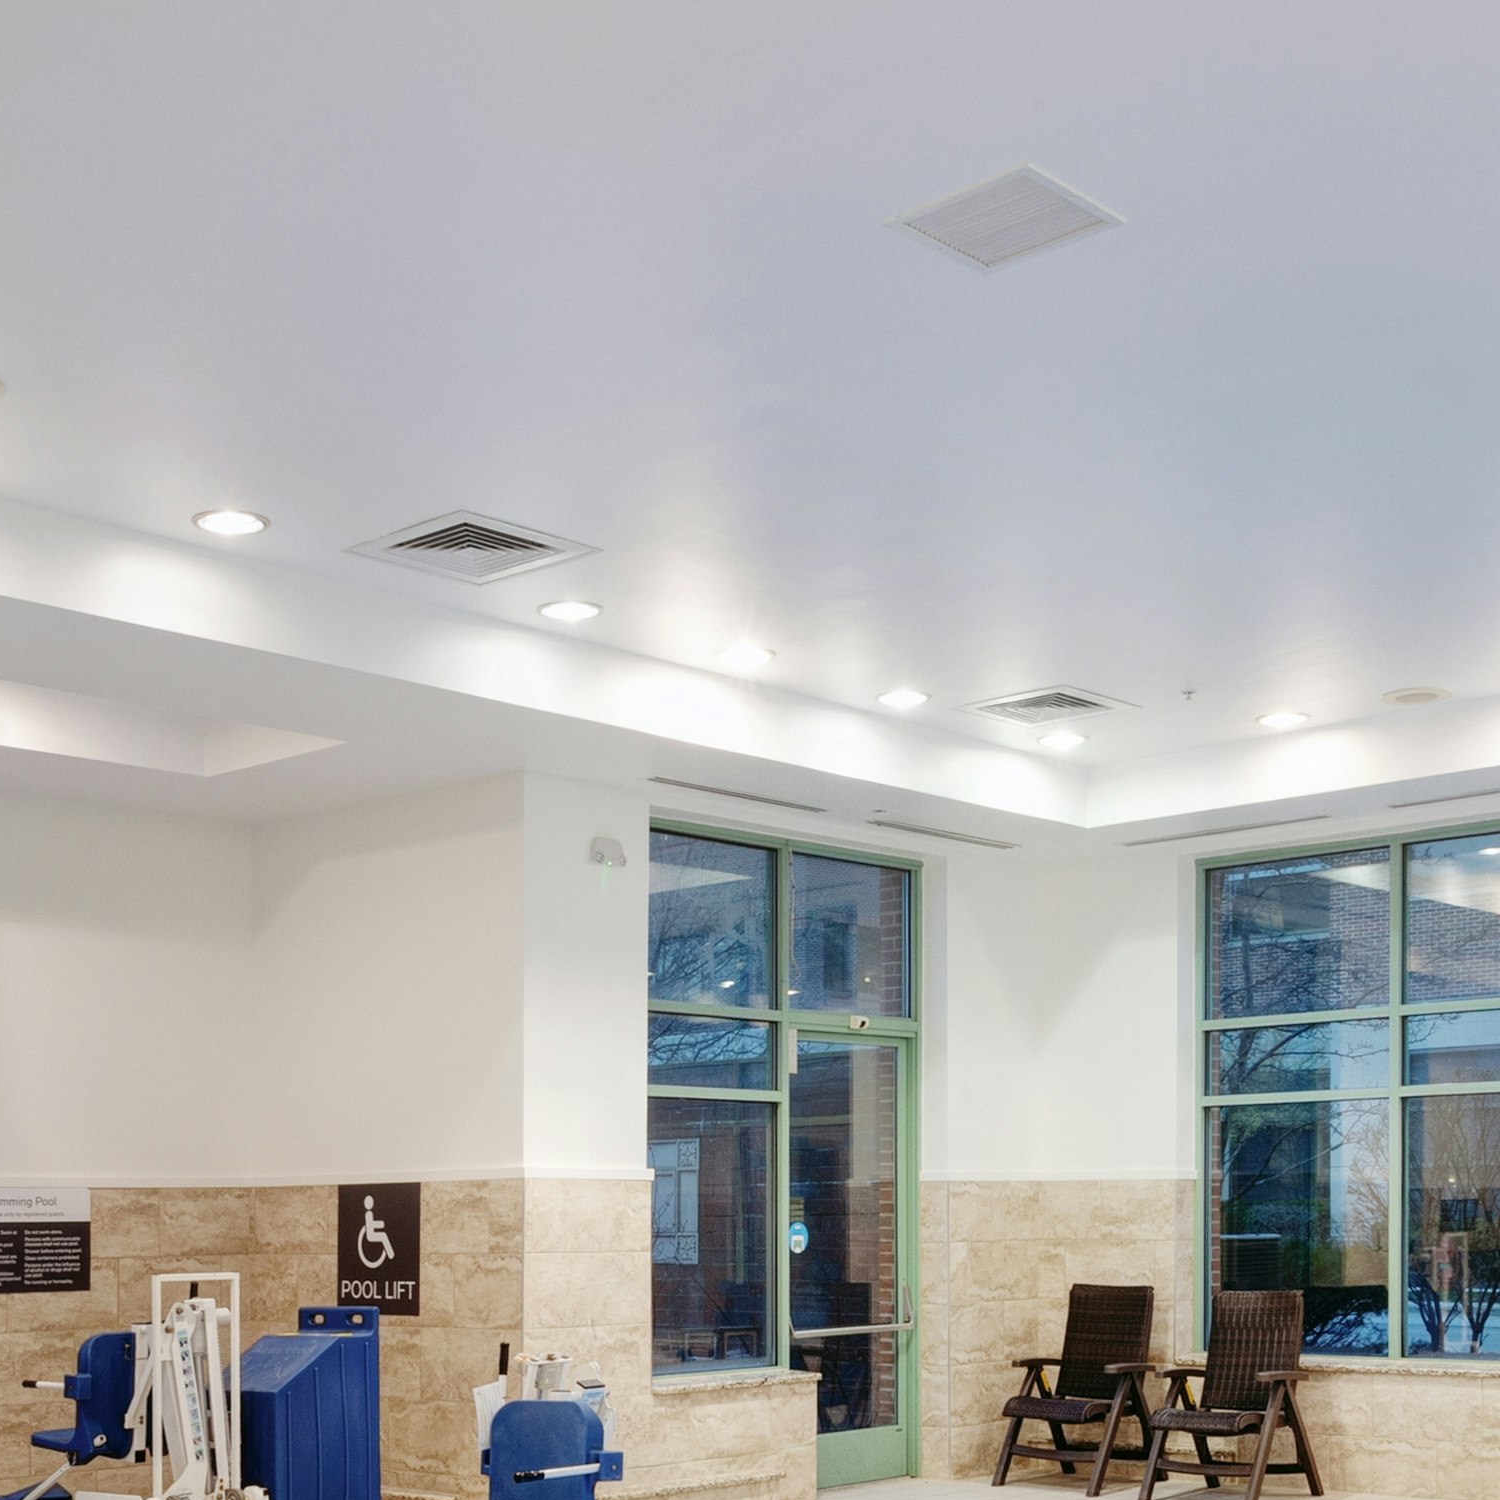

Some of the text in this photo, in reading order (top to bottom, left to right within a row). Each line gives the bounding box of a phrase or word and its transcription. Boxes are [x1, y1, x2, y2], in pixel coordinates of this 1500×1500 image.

[35, 1196, 57, 1206] Pool
[342, 1280, 416, 1300] POOL LIFT
